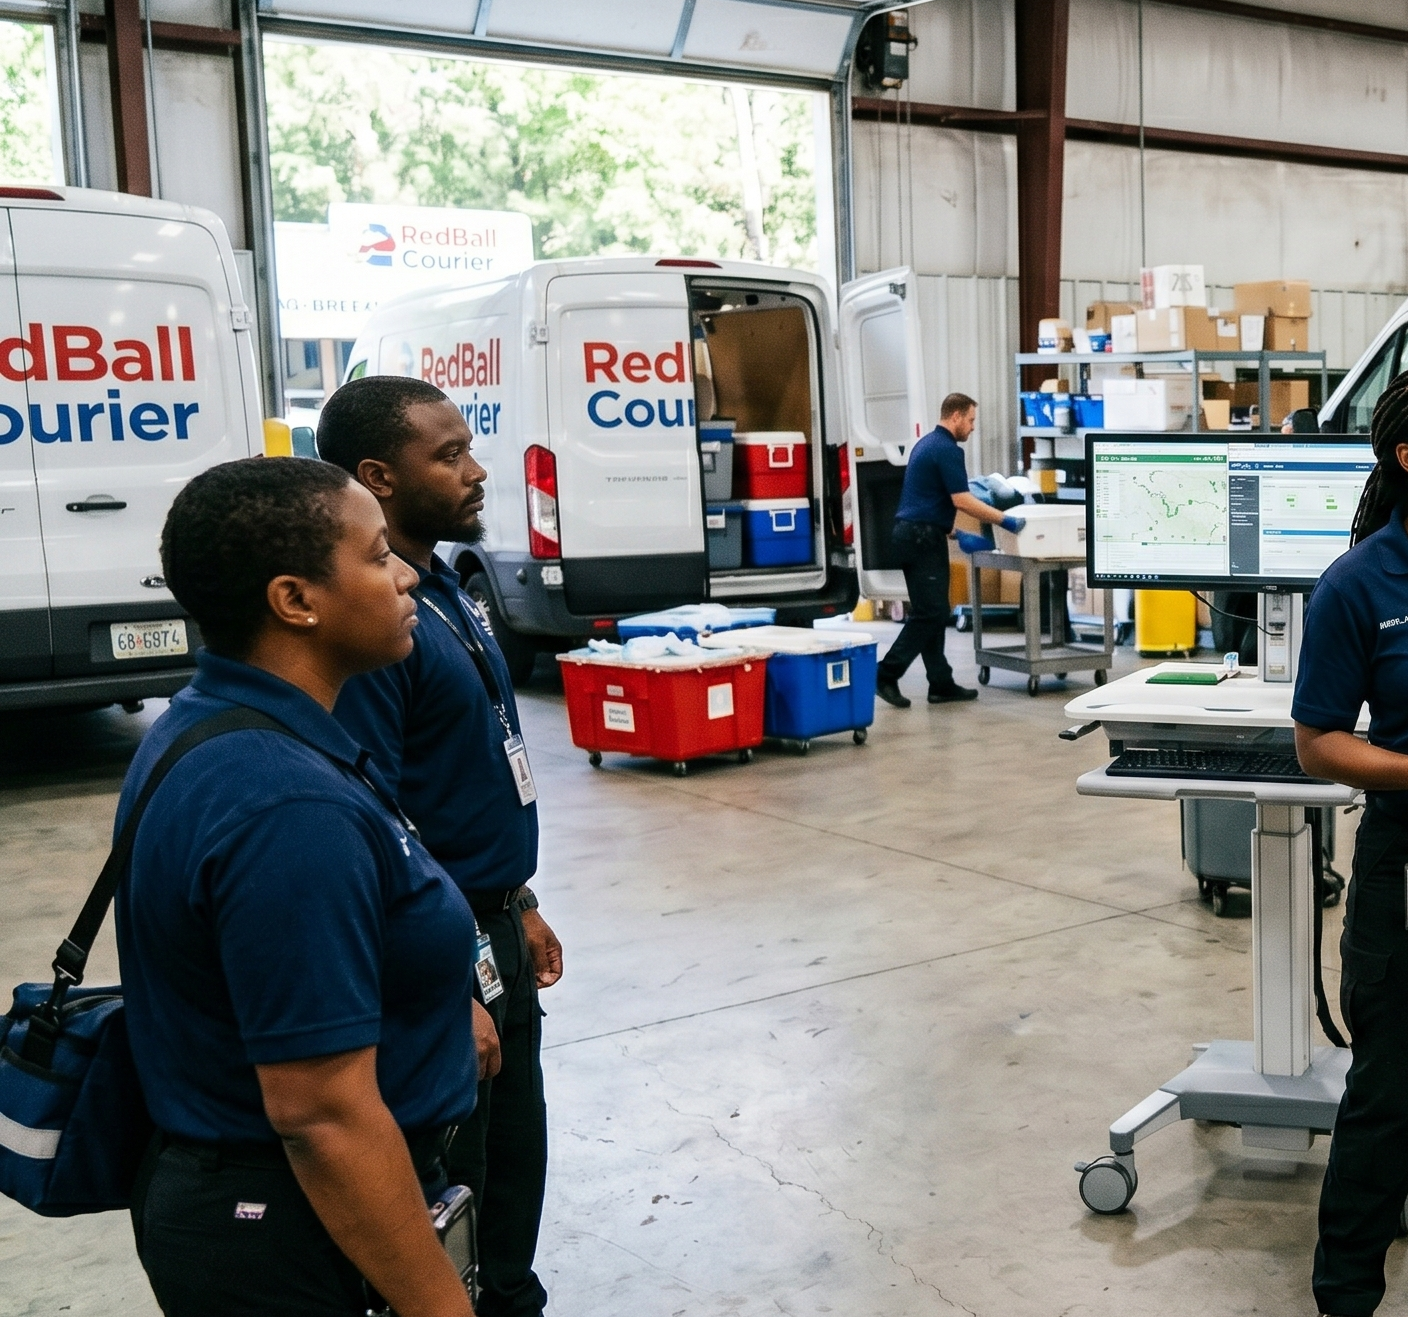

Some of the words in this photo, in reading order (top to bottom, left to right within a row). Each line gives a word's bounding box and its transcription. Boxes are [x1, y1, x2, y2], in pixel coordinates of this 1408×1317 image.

[402, 225, 497, 248] RedBall
[402, 250, 494, 271] Courier
[583, 341, 694, 384] Red
